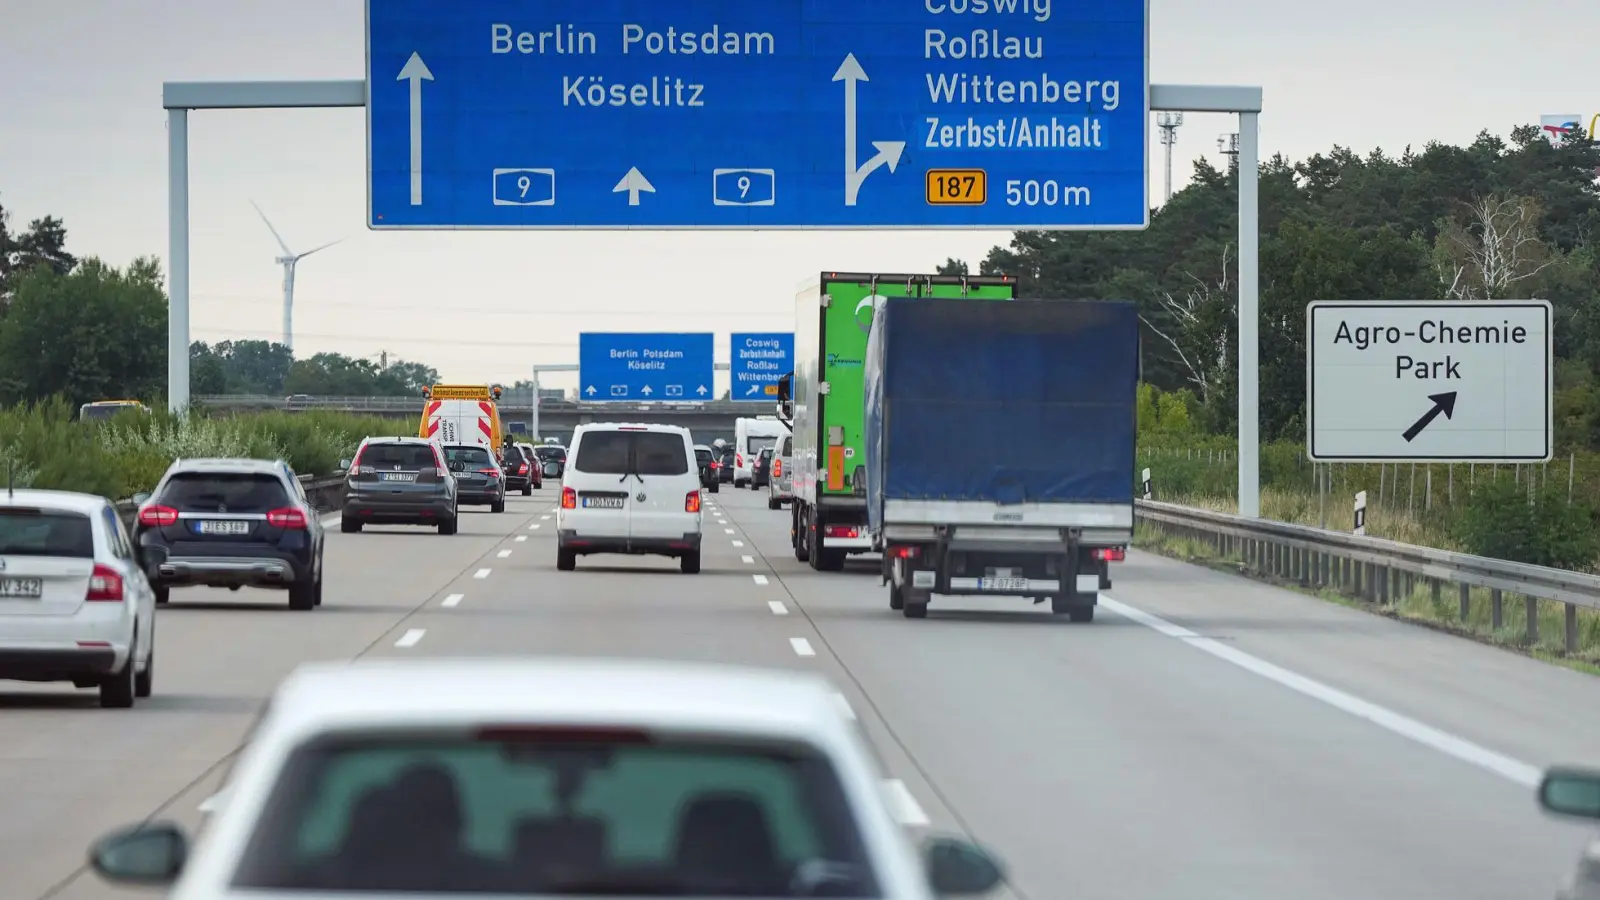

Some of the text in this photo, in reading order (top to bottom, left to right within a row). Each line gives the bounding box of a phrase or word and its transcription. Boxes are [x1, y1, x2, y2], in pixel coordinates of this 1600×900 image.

[491, 24, 775, 55] Berlin Potsdam
[925, 29, 1043, 59] Roßlau
[563, 76, 704, 107] Köselitz
[926, 73, 1120, 111] Wittenberg
[925, 117, 1101, 149] Zerbst/Anhalt
[517, 176, 531, 198] 9
[738, 176, 751, 198] 9
[936, 176, 976, 198] 187
[745, 338, 780, 349] Coswig
[1333, 319, 1527, 351] Agro-Chemie
[610, 348, 684, 358] Berlin Potsdam
[628, 360, 666, 370] Köselitz
[747, 360, 779, 370] Roßlau
[1396, 355, 1462, 379] Park
[15, 580, 39, 593] 342
